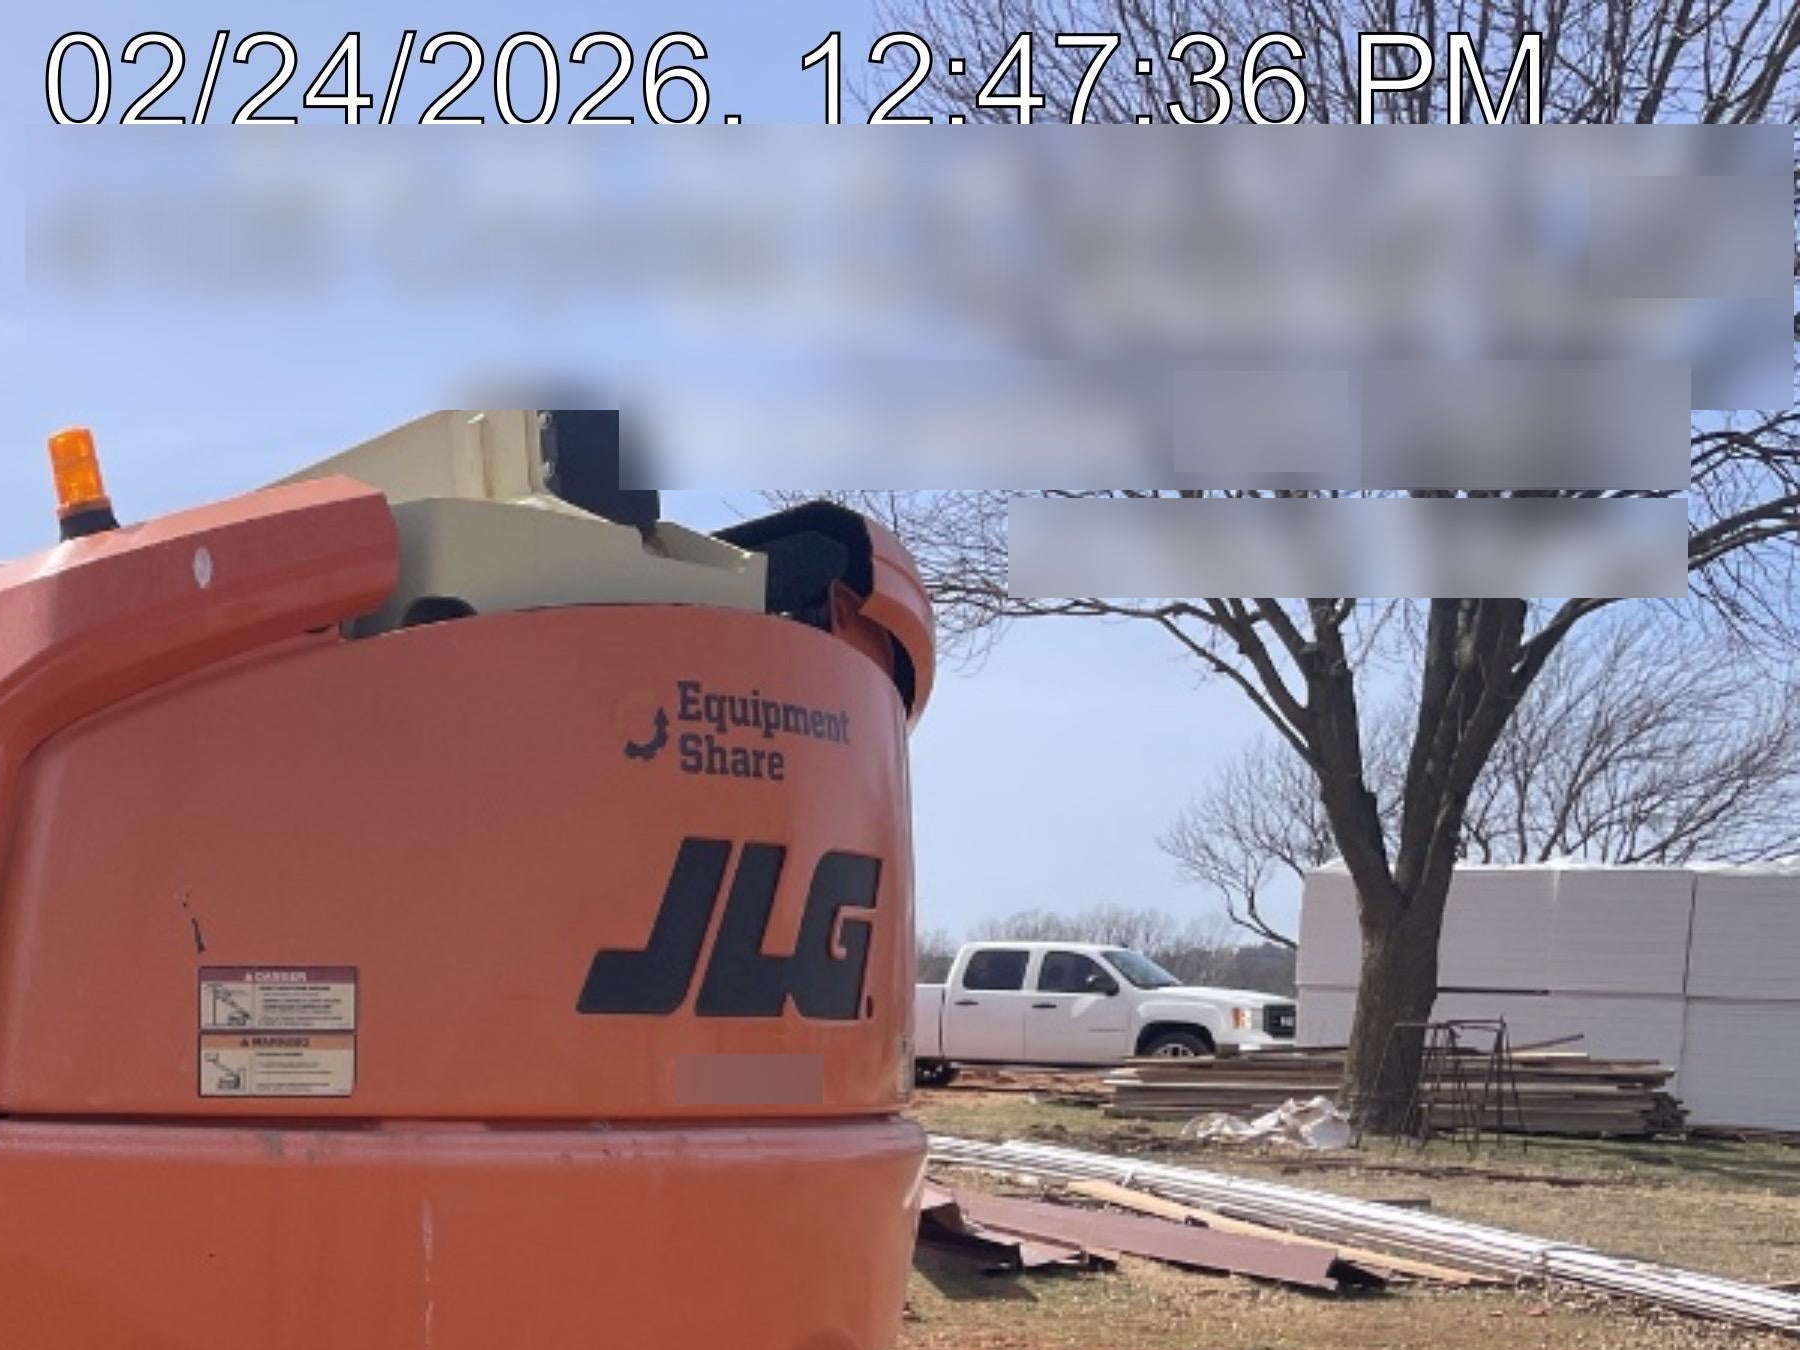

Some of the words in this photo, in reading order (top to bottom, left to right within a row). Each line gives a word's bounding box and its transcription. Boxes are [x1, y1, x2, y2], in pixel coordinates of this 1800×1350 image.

[677, 680, 850, 745] Equipment
[679, 734, 785, 781] Share
[576, 837, 883, 1020] JLG
